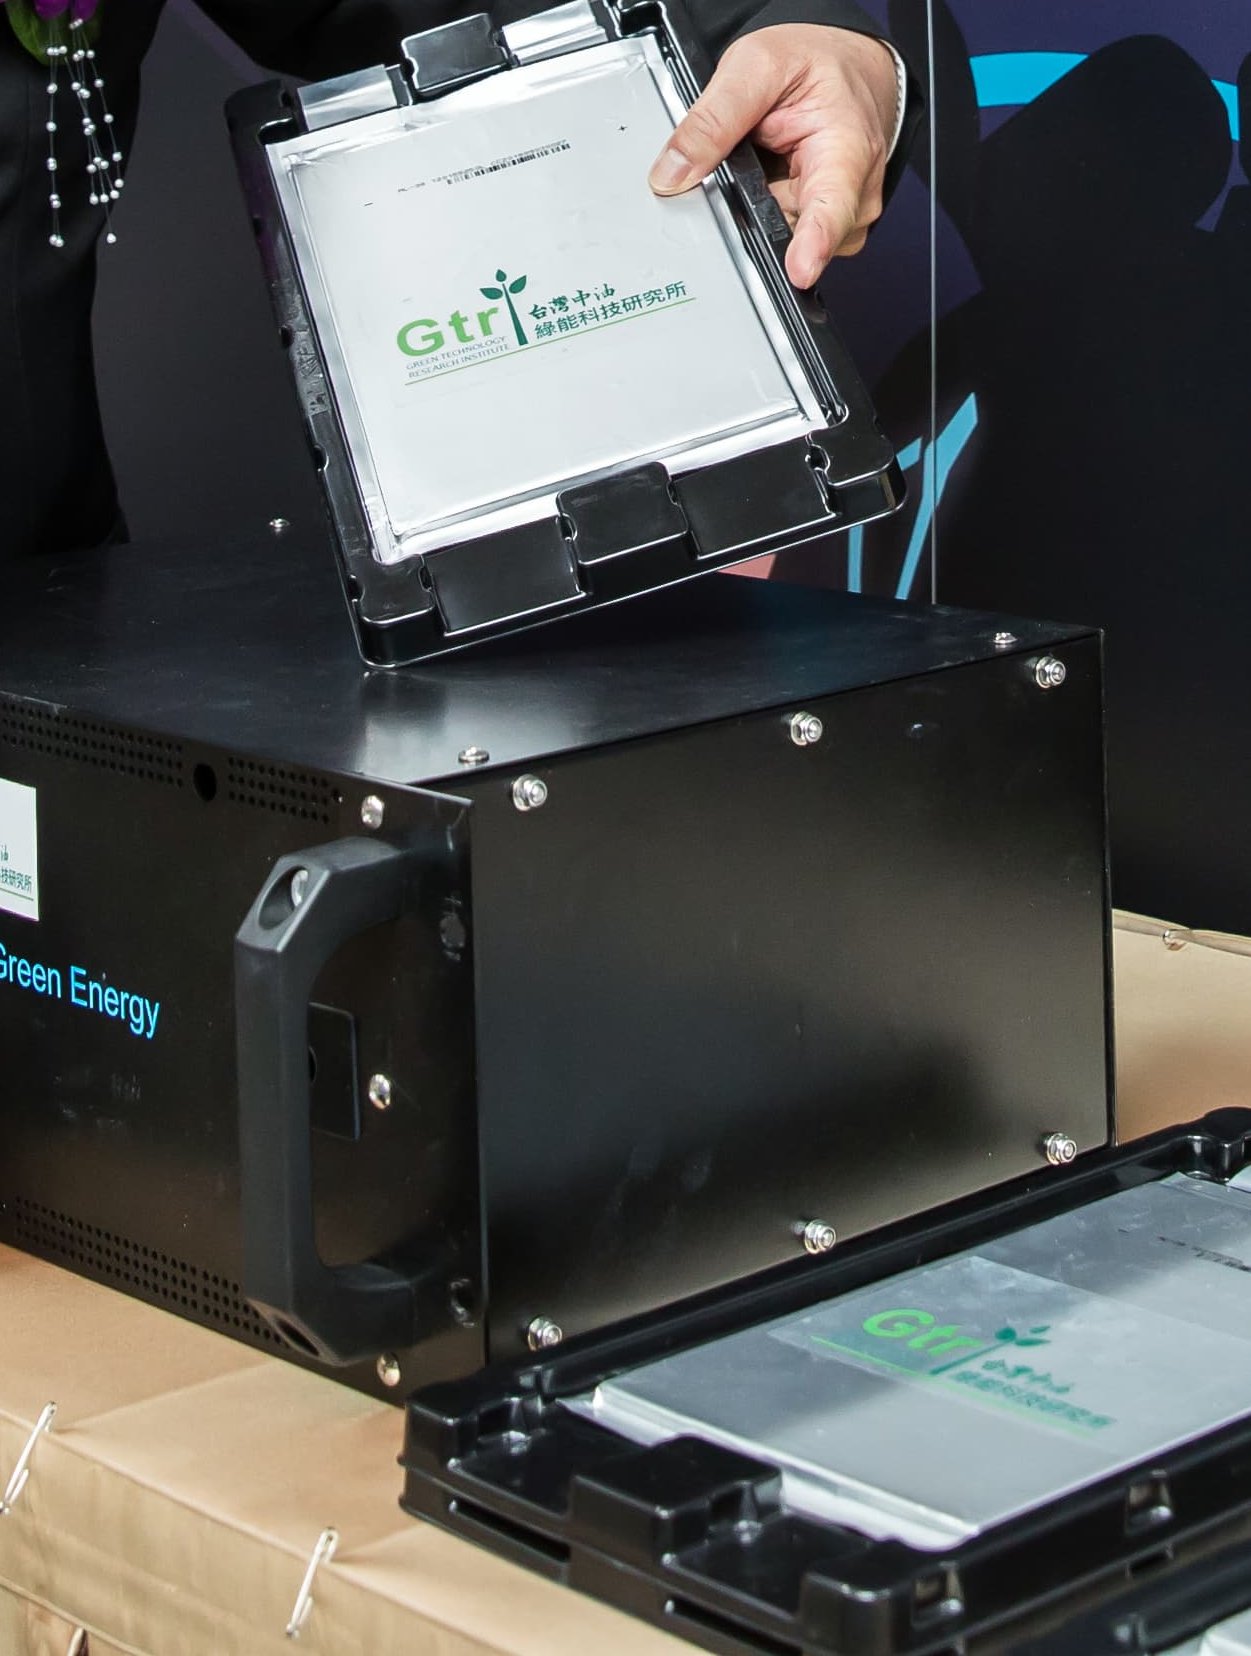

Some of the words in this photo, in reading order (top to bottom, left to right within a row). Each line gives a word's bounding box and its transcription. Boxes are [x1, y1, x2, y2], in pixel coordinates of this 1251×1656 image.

[528, 283, 616, 320] 台灣中油
[534, 280, 687, 339] 綠能科技研究所
[405, 353, 439, 371] GREEN
[441, 335, 508, 360] TECHNOLOGY
[69, 964, 160, 1039] Energy
